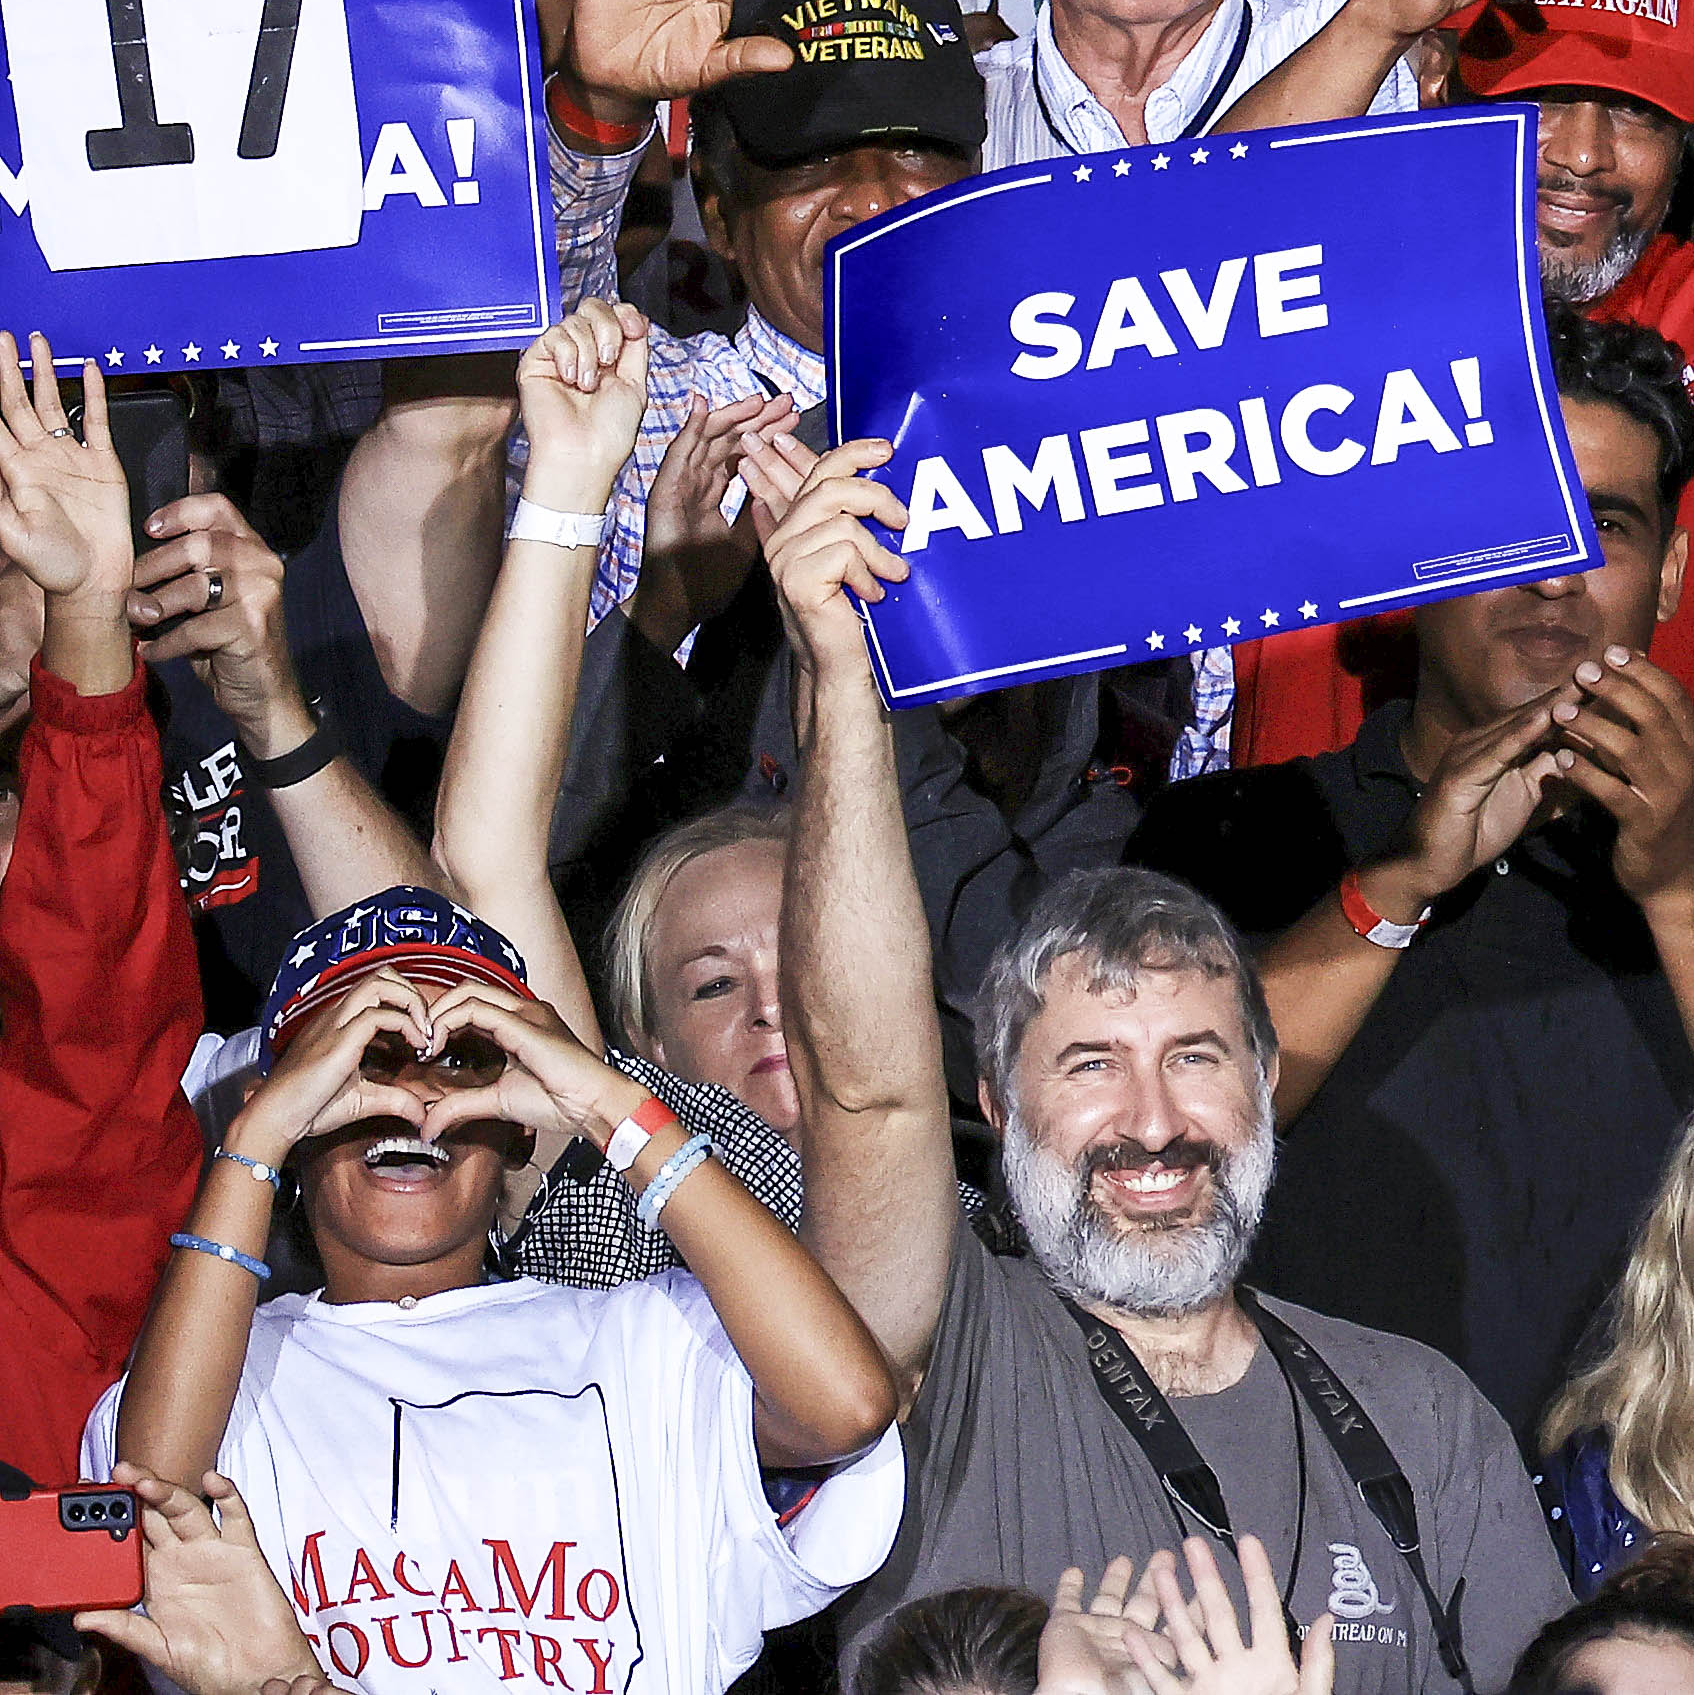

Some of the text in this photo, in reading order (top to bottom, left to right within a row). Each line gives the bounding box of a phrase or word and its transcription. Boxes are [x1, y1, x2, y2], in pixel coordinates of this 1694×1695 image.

[797, 36, 926, 63] VETERAN
[1008, 243, 1330, 382] SAVE
[901, 356, 1495, 554] AMERICA!
[181, 742, 241, 810] LE
[333, 904, 487, 962] USA
[1331, 1623, 1376, 1643] TREAD
[1377, 1627, 1395, 1645] ON
